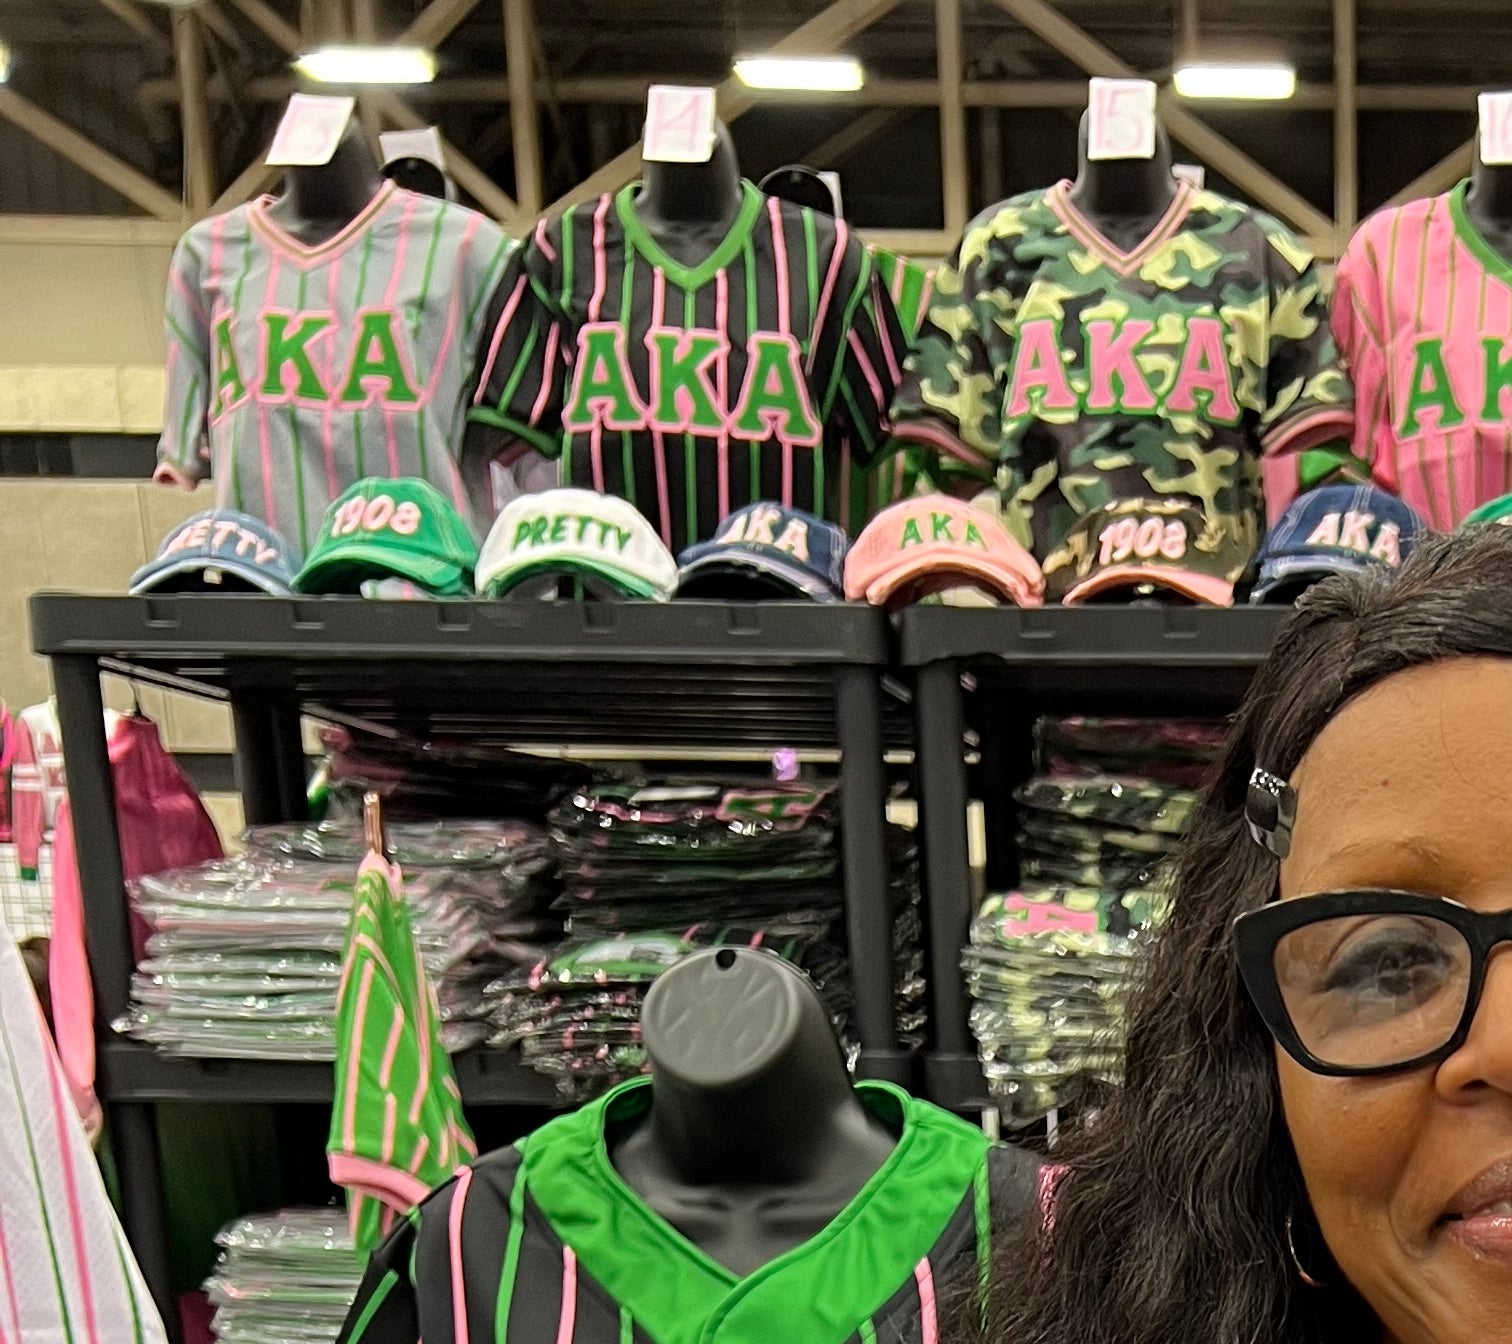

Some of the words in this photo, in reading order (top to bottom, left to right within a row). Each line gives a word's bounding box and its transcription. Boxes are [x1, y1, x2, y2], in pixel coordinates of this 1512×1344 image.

[650, 92, 702, 153] 14
[1094, 86, 1146, 151] 15
[209, 306, 425, 426] AKA
[564, 320, 822, 446] AKA
[1006, 314, 1241, 424] AKA
[331, 495, 422, 539] 1908
[512, 514, 632, 552] PRETTY
[716, 505, 810, 563] AKA
[900, 511, 989, 552] AKA
[1099, 516, 1188, 566] 1908
[1305, 510, 1402, 568] AKA
